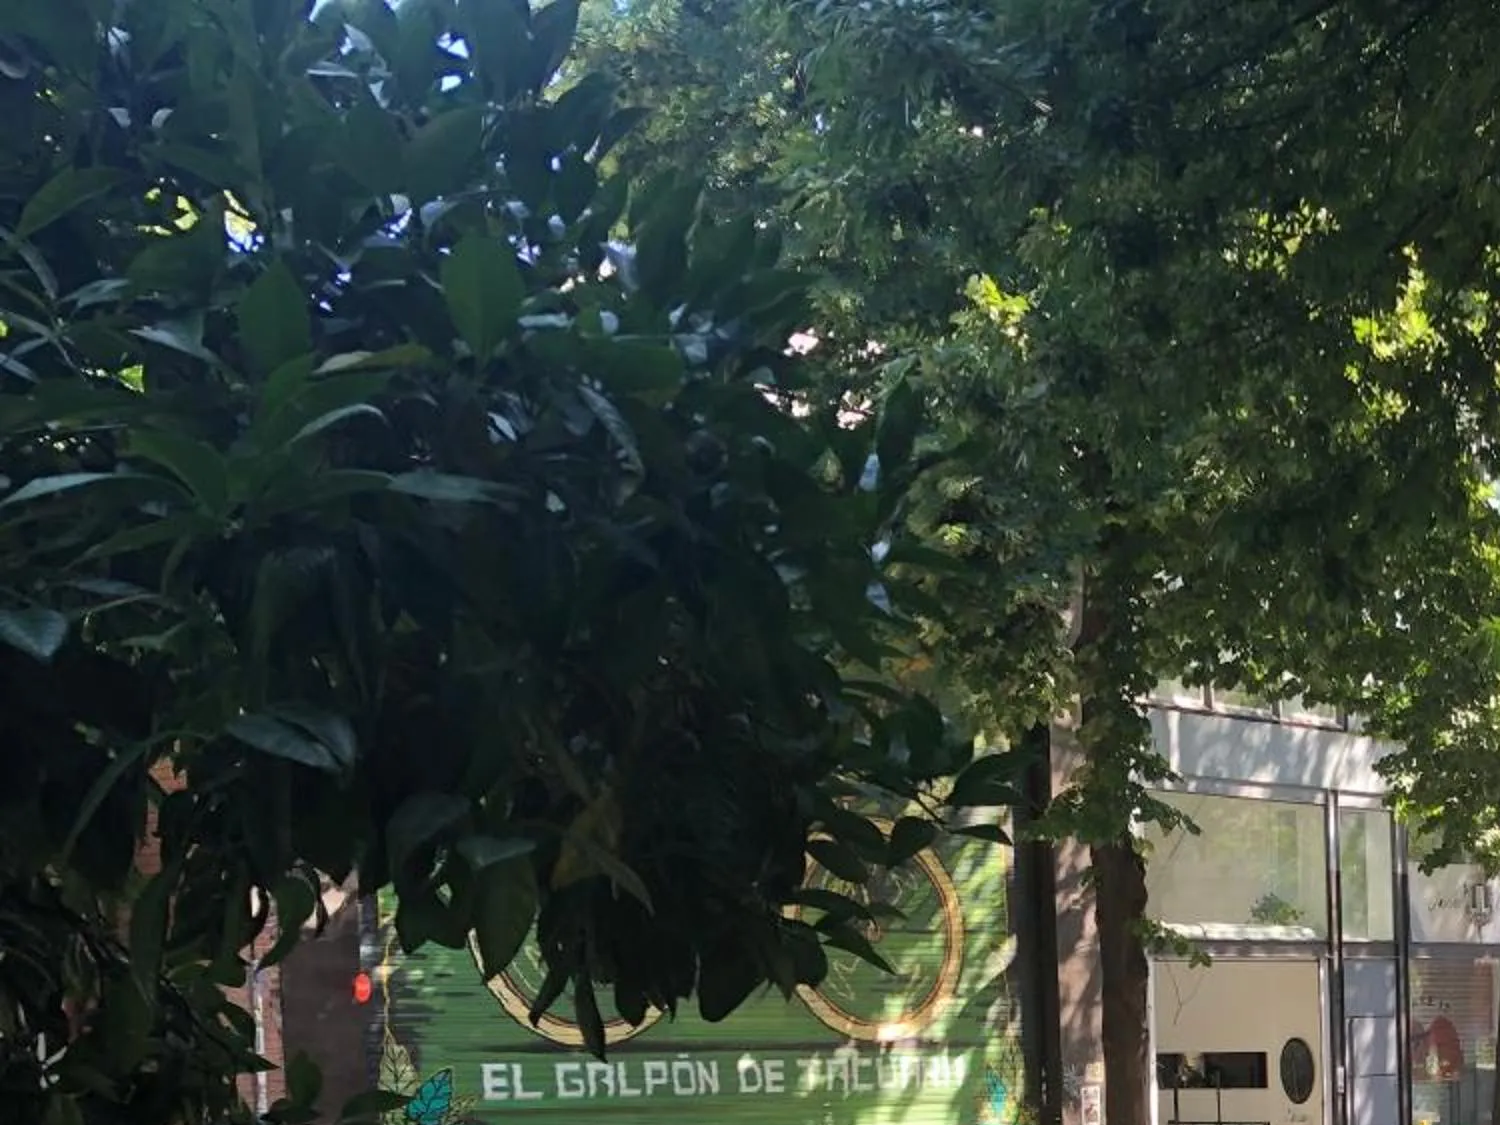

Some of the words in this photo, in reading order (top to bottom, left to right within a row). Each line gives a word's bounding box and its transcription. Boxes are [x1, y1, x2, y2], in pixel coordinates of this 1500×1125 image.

[480, 1062, 544, 1100] EL
[555, 1053, 720, 1098] GALPÓN
[737, 1056, 785, 1093] DE
